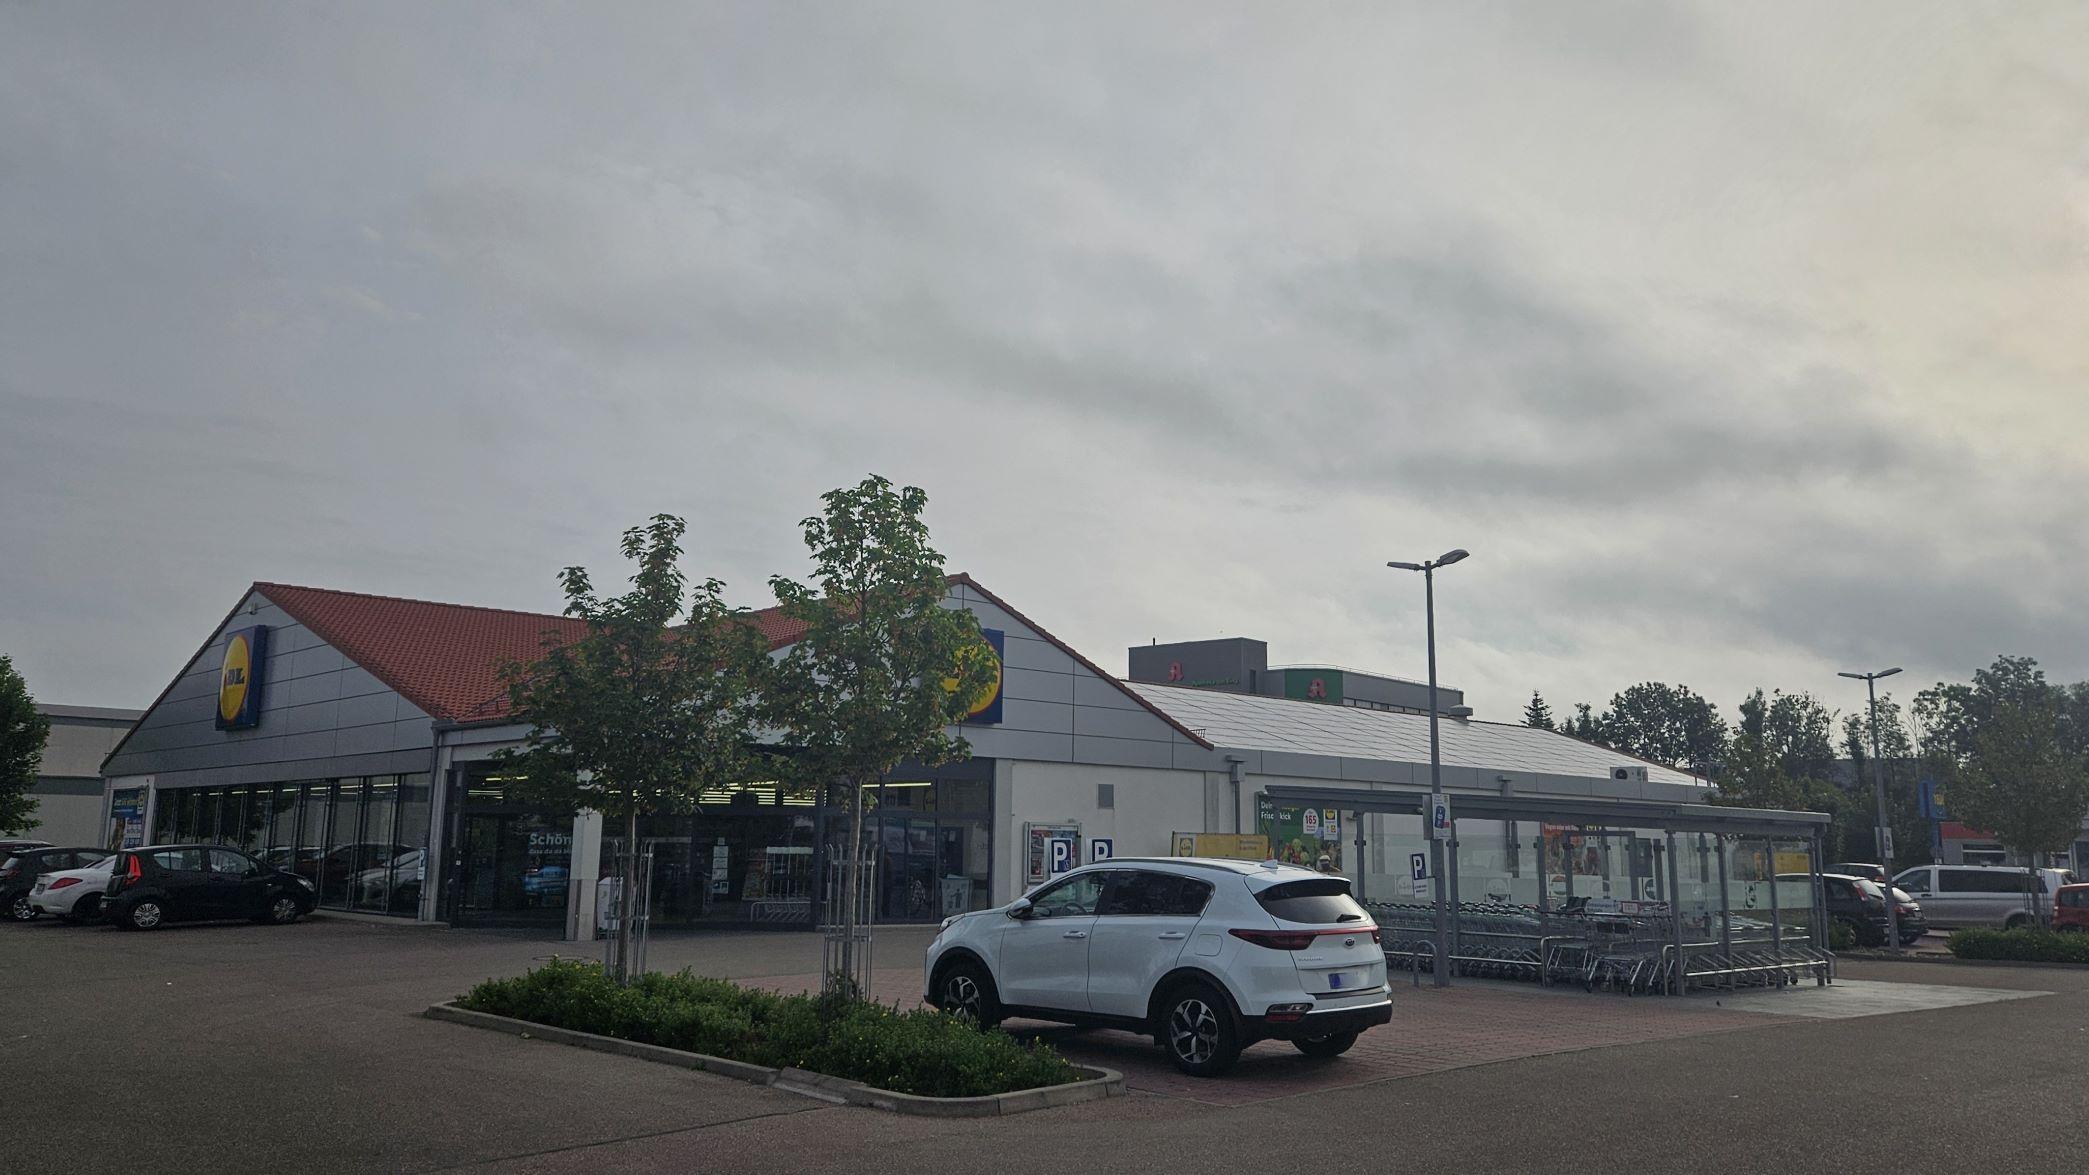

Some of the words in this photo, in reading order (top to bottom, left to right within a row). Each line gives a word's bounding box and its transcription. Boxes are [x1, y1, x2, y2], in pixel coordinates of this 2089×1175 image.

[1305, 815, 1317, 825] 165
[1054, 842, 1067, 871] P
[1095, 842, 1108, 862] P
[1412, 855, 1423, 879] P
